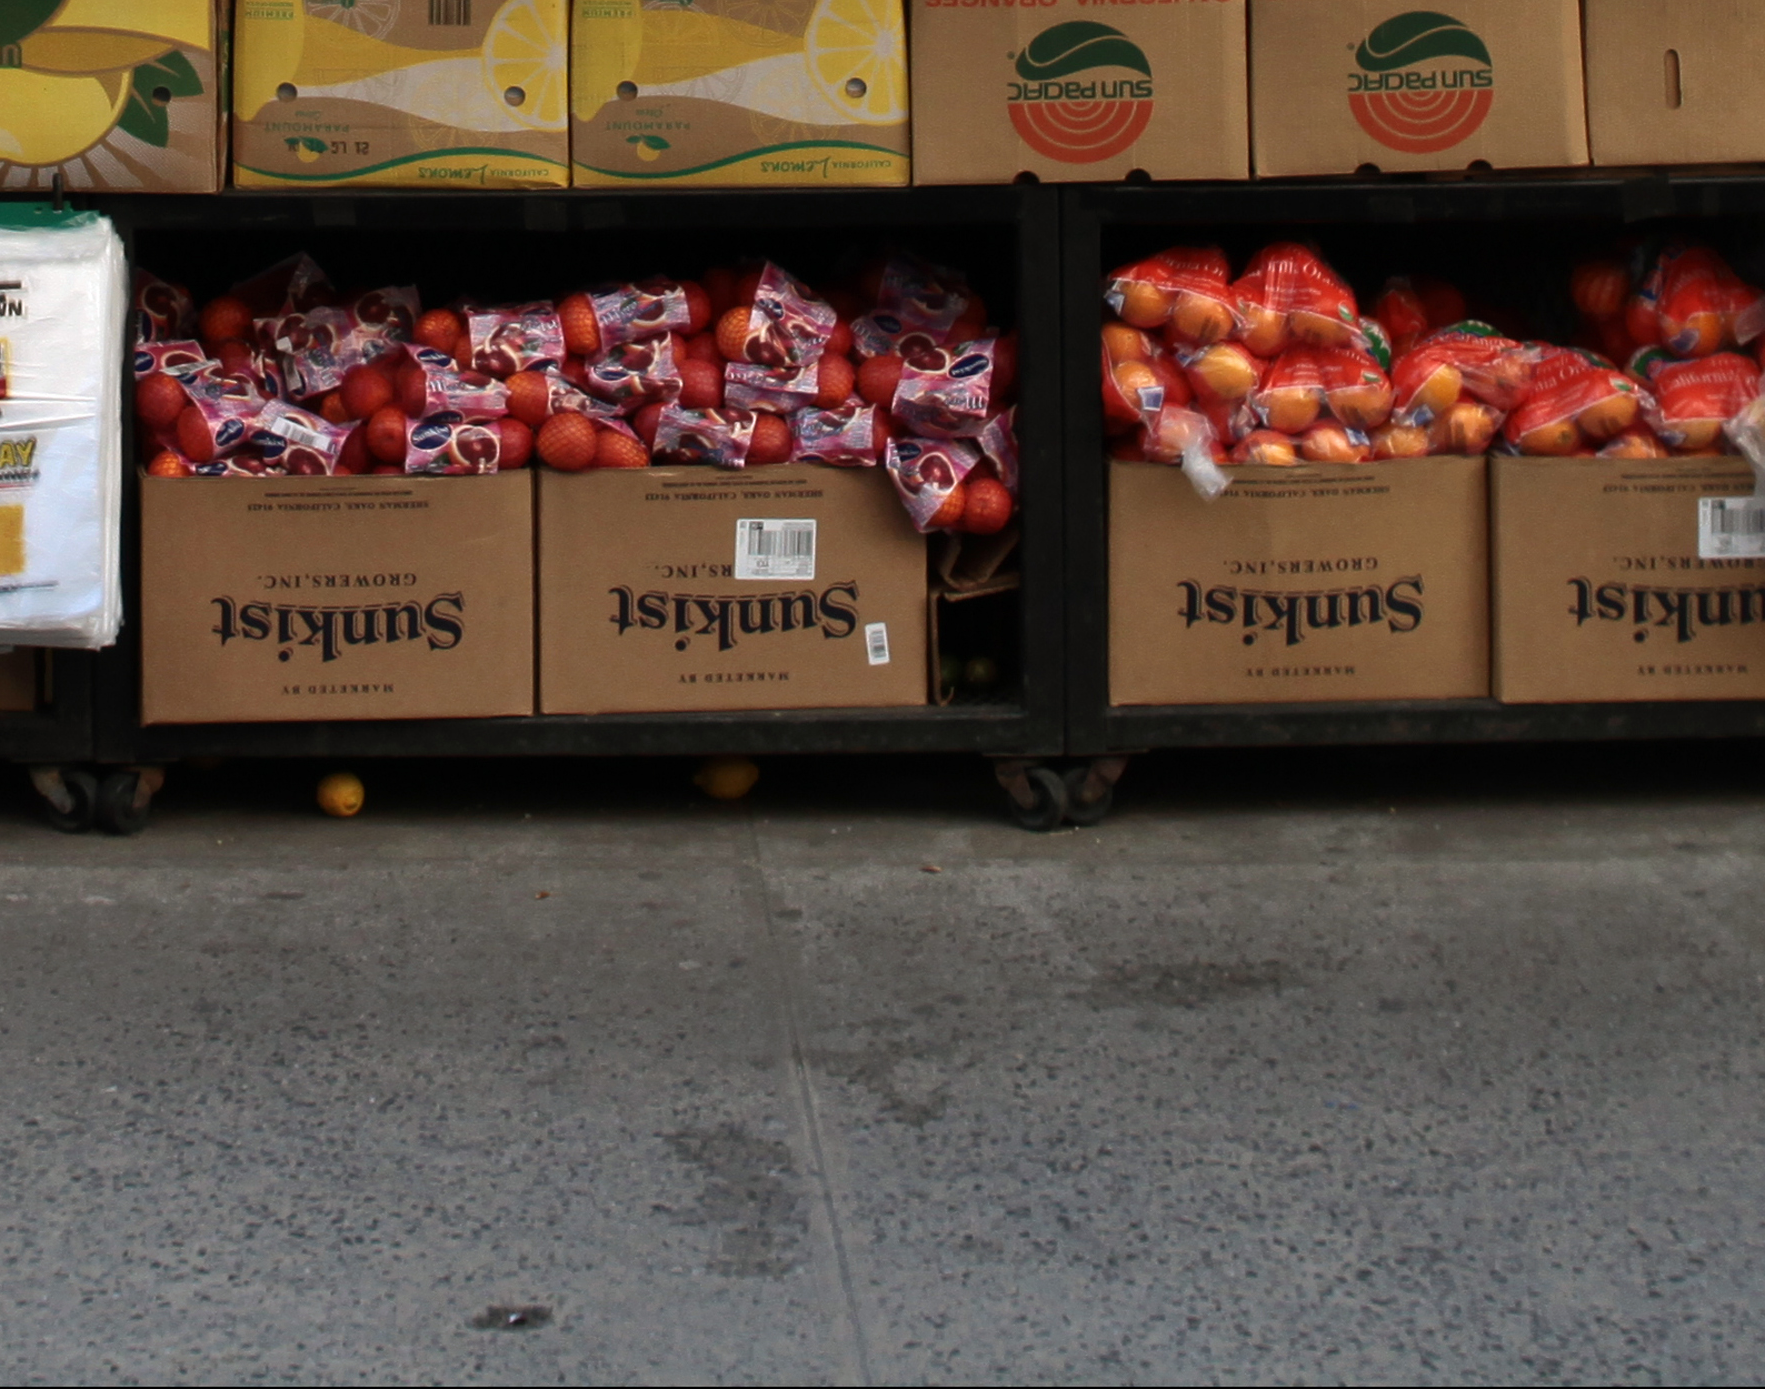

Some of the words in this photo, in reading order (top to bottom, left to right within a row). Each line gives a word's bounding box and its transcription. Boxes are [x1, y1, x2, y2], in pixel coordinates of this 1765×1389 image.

[1176, 573, 1424, 646] Sunkist
[609, 580, 860, 652] Sunkist
[211, 591, 465, 663] Sunkist
[1271, 666, 1355, 677] MARKETED
[677, 673, 697, 683] BY
[704, 672, 789, 683] MARKETED
[280, 685, 300, 695] BY
[307, 683, 394, 694] MARKETED
